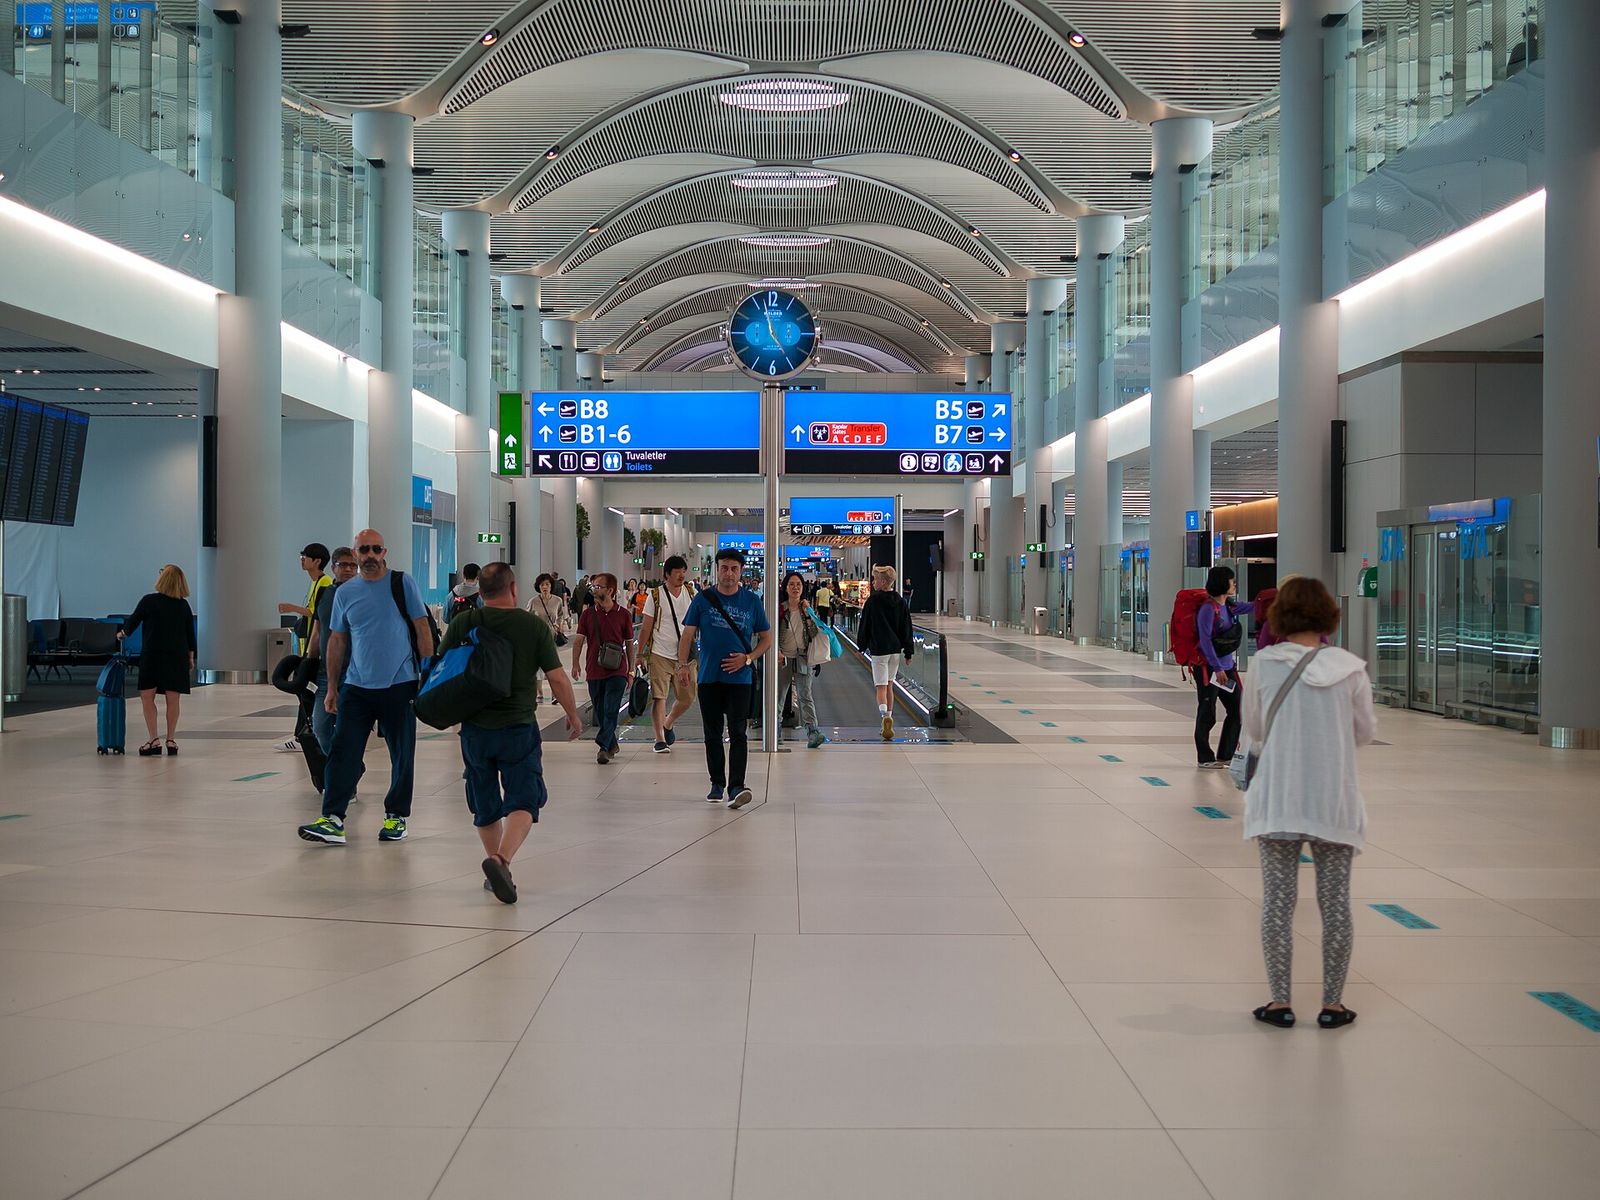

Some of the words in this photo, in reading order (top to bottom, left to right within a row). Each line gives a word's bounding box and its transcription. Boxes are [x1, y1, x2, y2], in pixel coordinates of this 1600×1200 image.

[768, 291, 778, 307] 12
[769, 360, 776, 376] 6
[580, 399, 609, 419] B8
[935, 400, 964, 420] B5
[580, 425, 631, 444] B1-6
[832, 435, 839, 443] A
[843, 435, 850, 443] C
[854, 435, 862, 443] D
[866, 435, 872, 443] E
[876, 435, 882, 443] F
[935, 425, 963, 444] B7
[625, 451, 667, 460] Tuvaletler
[625, 462, 653, 471] Toilets
[1381, 527, 1405, 561] B7A
[1460, 523, 1488, 561] B7A
